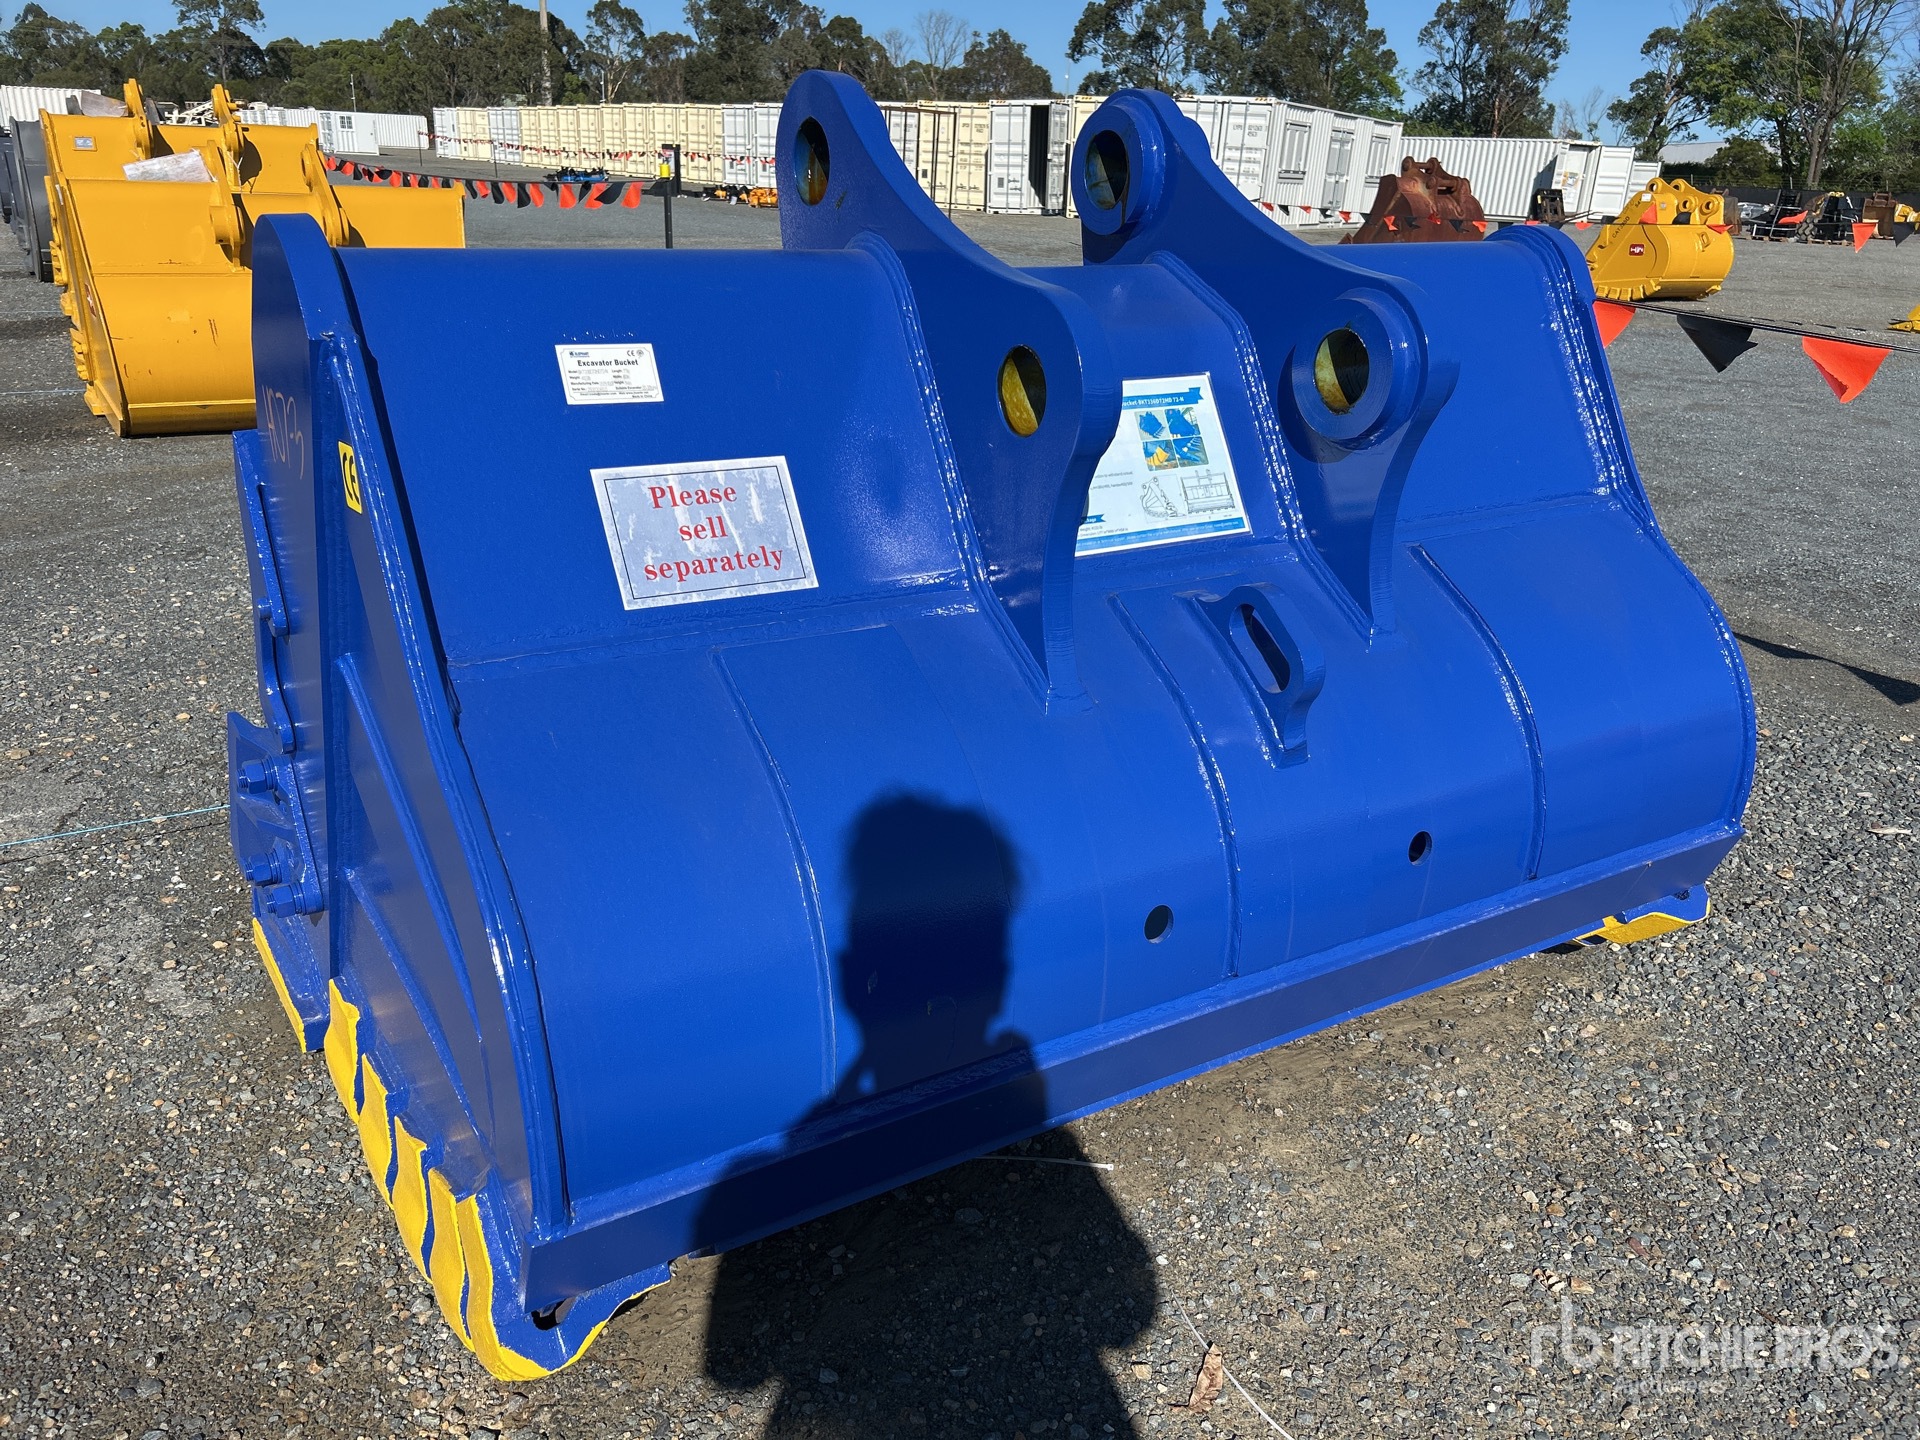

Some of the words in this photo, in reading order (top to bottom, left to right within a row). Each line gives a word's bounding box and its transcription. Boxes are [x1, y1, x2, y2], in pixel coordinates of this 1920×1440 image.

[577, 359, 612, 367] Excavator
[614, 358, 639, 366] Bucket
[648, 485, 738, 509] Please
[679, 515, 728, 542] sell
[644, 545, 783, 582] separately
